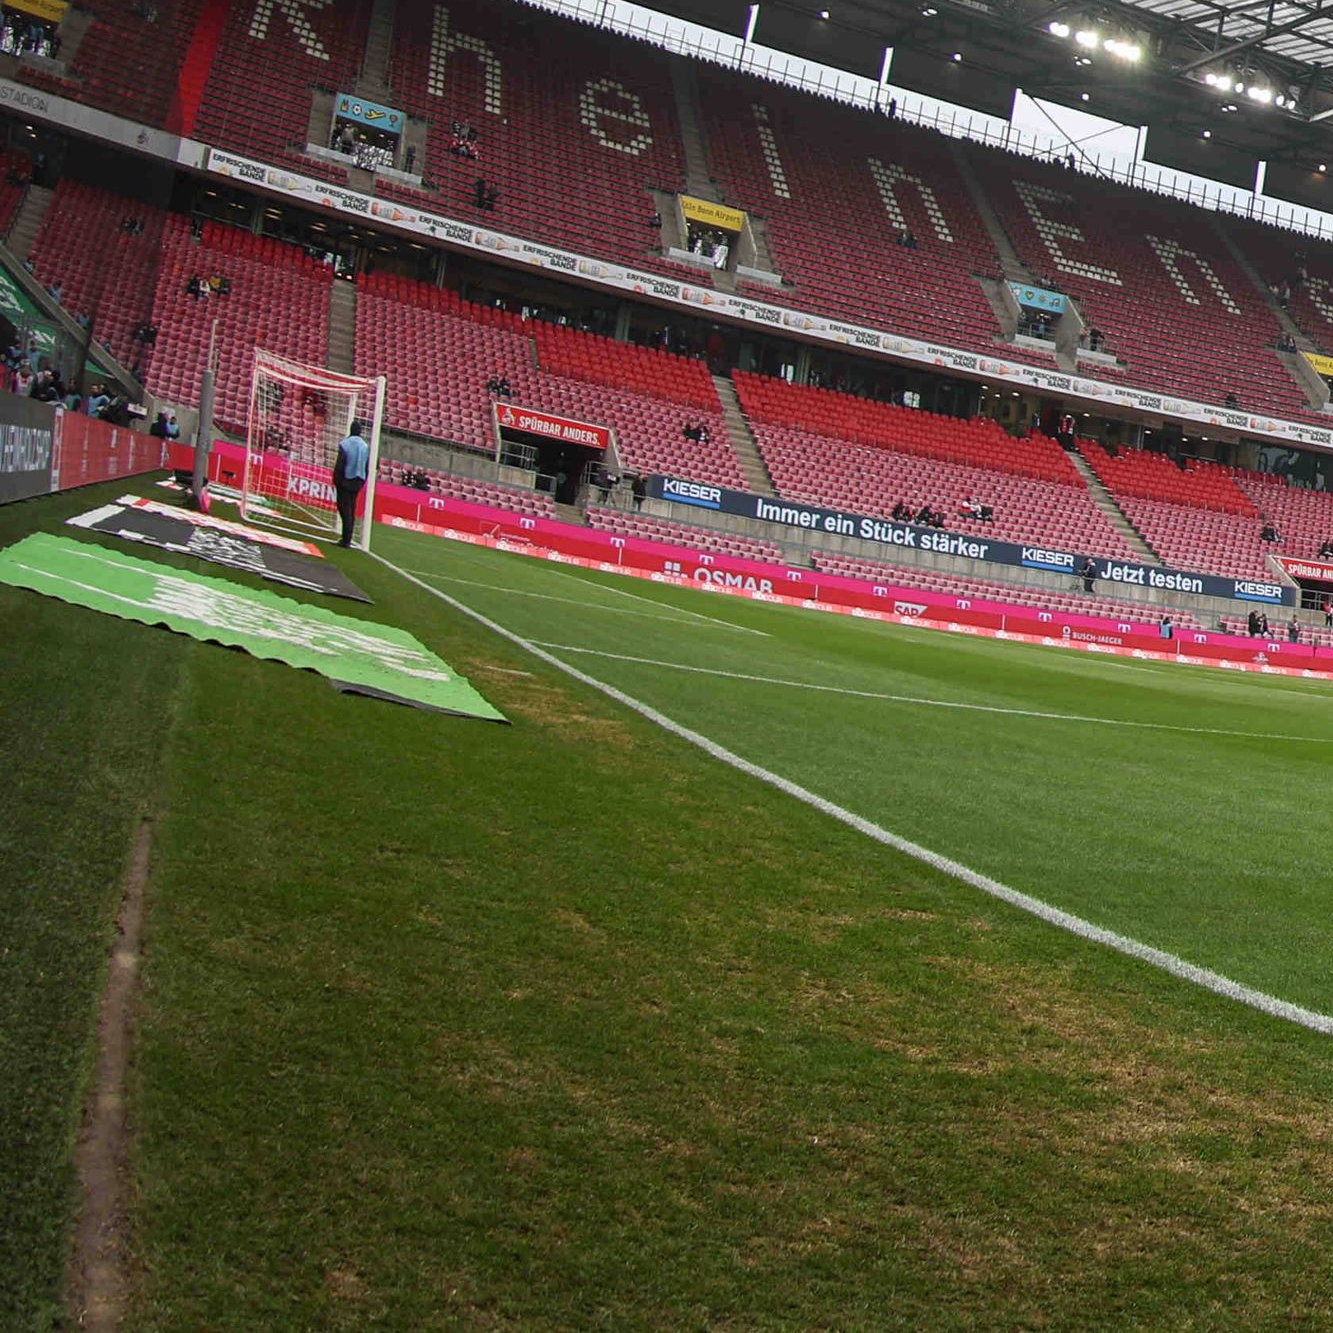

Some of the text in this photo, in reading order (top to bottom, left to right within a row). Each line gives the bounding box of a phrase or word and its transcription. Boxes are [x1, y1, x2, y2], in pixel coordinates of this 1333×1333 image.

[213, 153, 268, 176] ERFRISCHENDE
[239, 167, 266, 183] BANDE
[315, 185, 370, 207] ERFRISCHENDE
[342, 198, 368, 214] BANDE
[419, 216, 473, 237] ERFRISCHENDE
[446, 229, 472, 243] BANDE
[519, 416, 601, 446] SPÜRBAR ANDERS.
[663, 478, 721, 502] KIESER
[756, 498, 989, 559] Immer ein Stück stärker
[1022, 547, 1075, 567] KIESER
[1101, 562, 1203, 594] Jetzt testen
[1288, 563, 1321, 579] SPÜRBAR
[1235, 581, 1283, 599] KIESER
[1073, 632, 1122, 645] BUSCH-JAEGER
